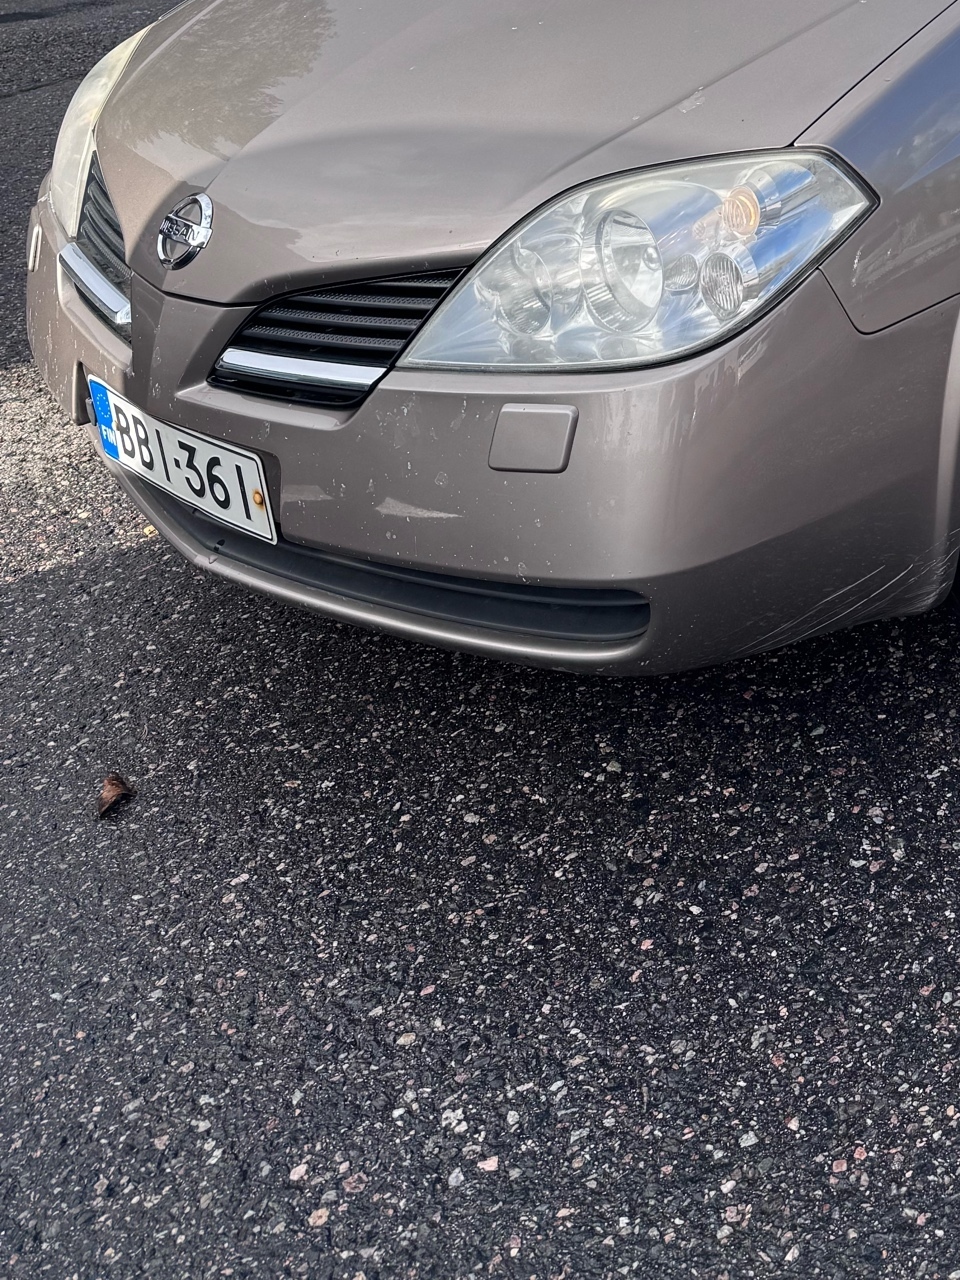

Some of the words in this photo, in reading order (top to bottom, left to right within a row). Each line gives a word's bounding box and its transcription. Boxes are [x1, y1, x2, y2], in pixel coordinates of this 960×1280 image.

[159, 220, 200, 242] NISSAN
[101, 425, 117, 446] FIN
[113, 404, 252, 522] BBI-361
